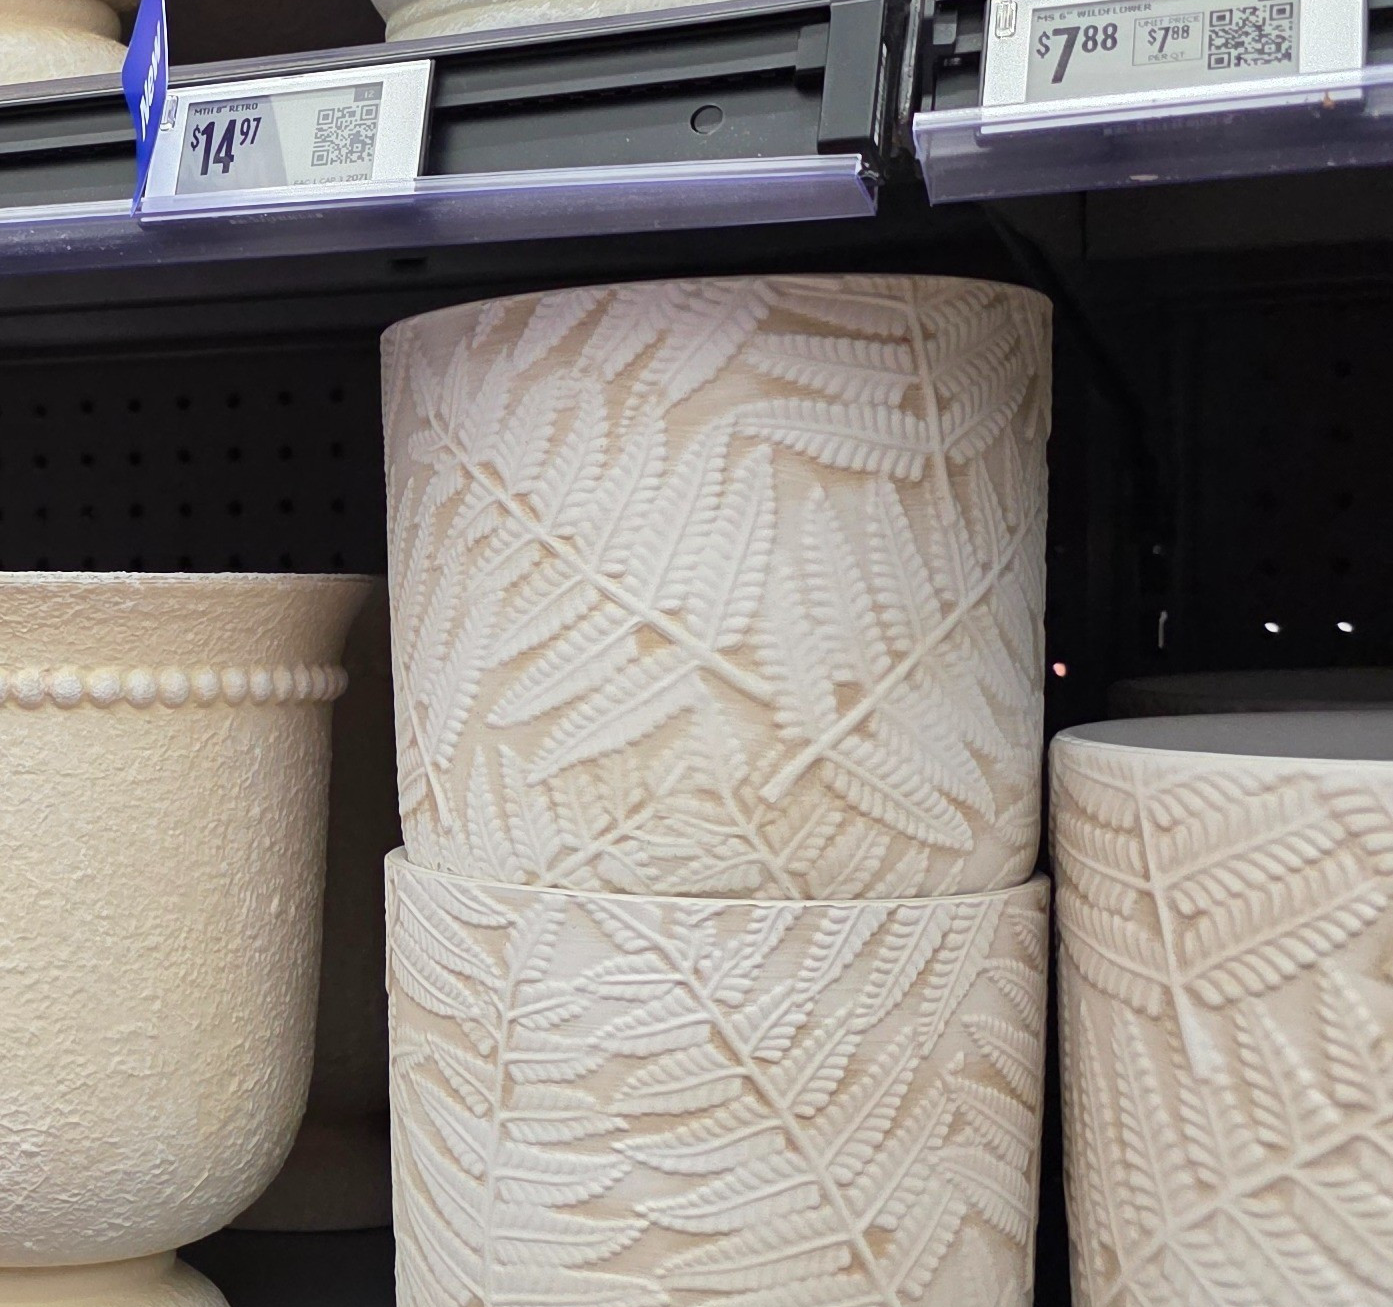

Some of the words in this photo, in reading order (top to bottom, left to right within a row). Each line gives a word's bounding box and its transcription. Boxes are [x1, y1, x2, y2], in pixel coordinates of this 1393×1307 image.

[1077, 3, 1153, 19] WILDFLOWER
[1138, 18, 1164, 29] UNIT
[1168, 15, 1200, 25] PRICE
[1148, 53, 1168, 62] PER
[140, 20, 161, 142] New
[229, 102, 259, 112] RETRO
